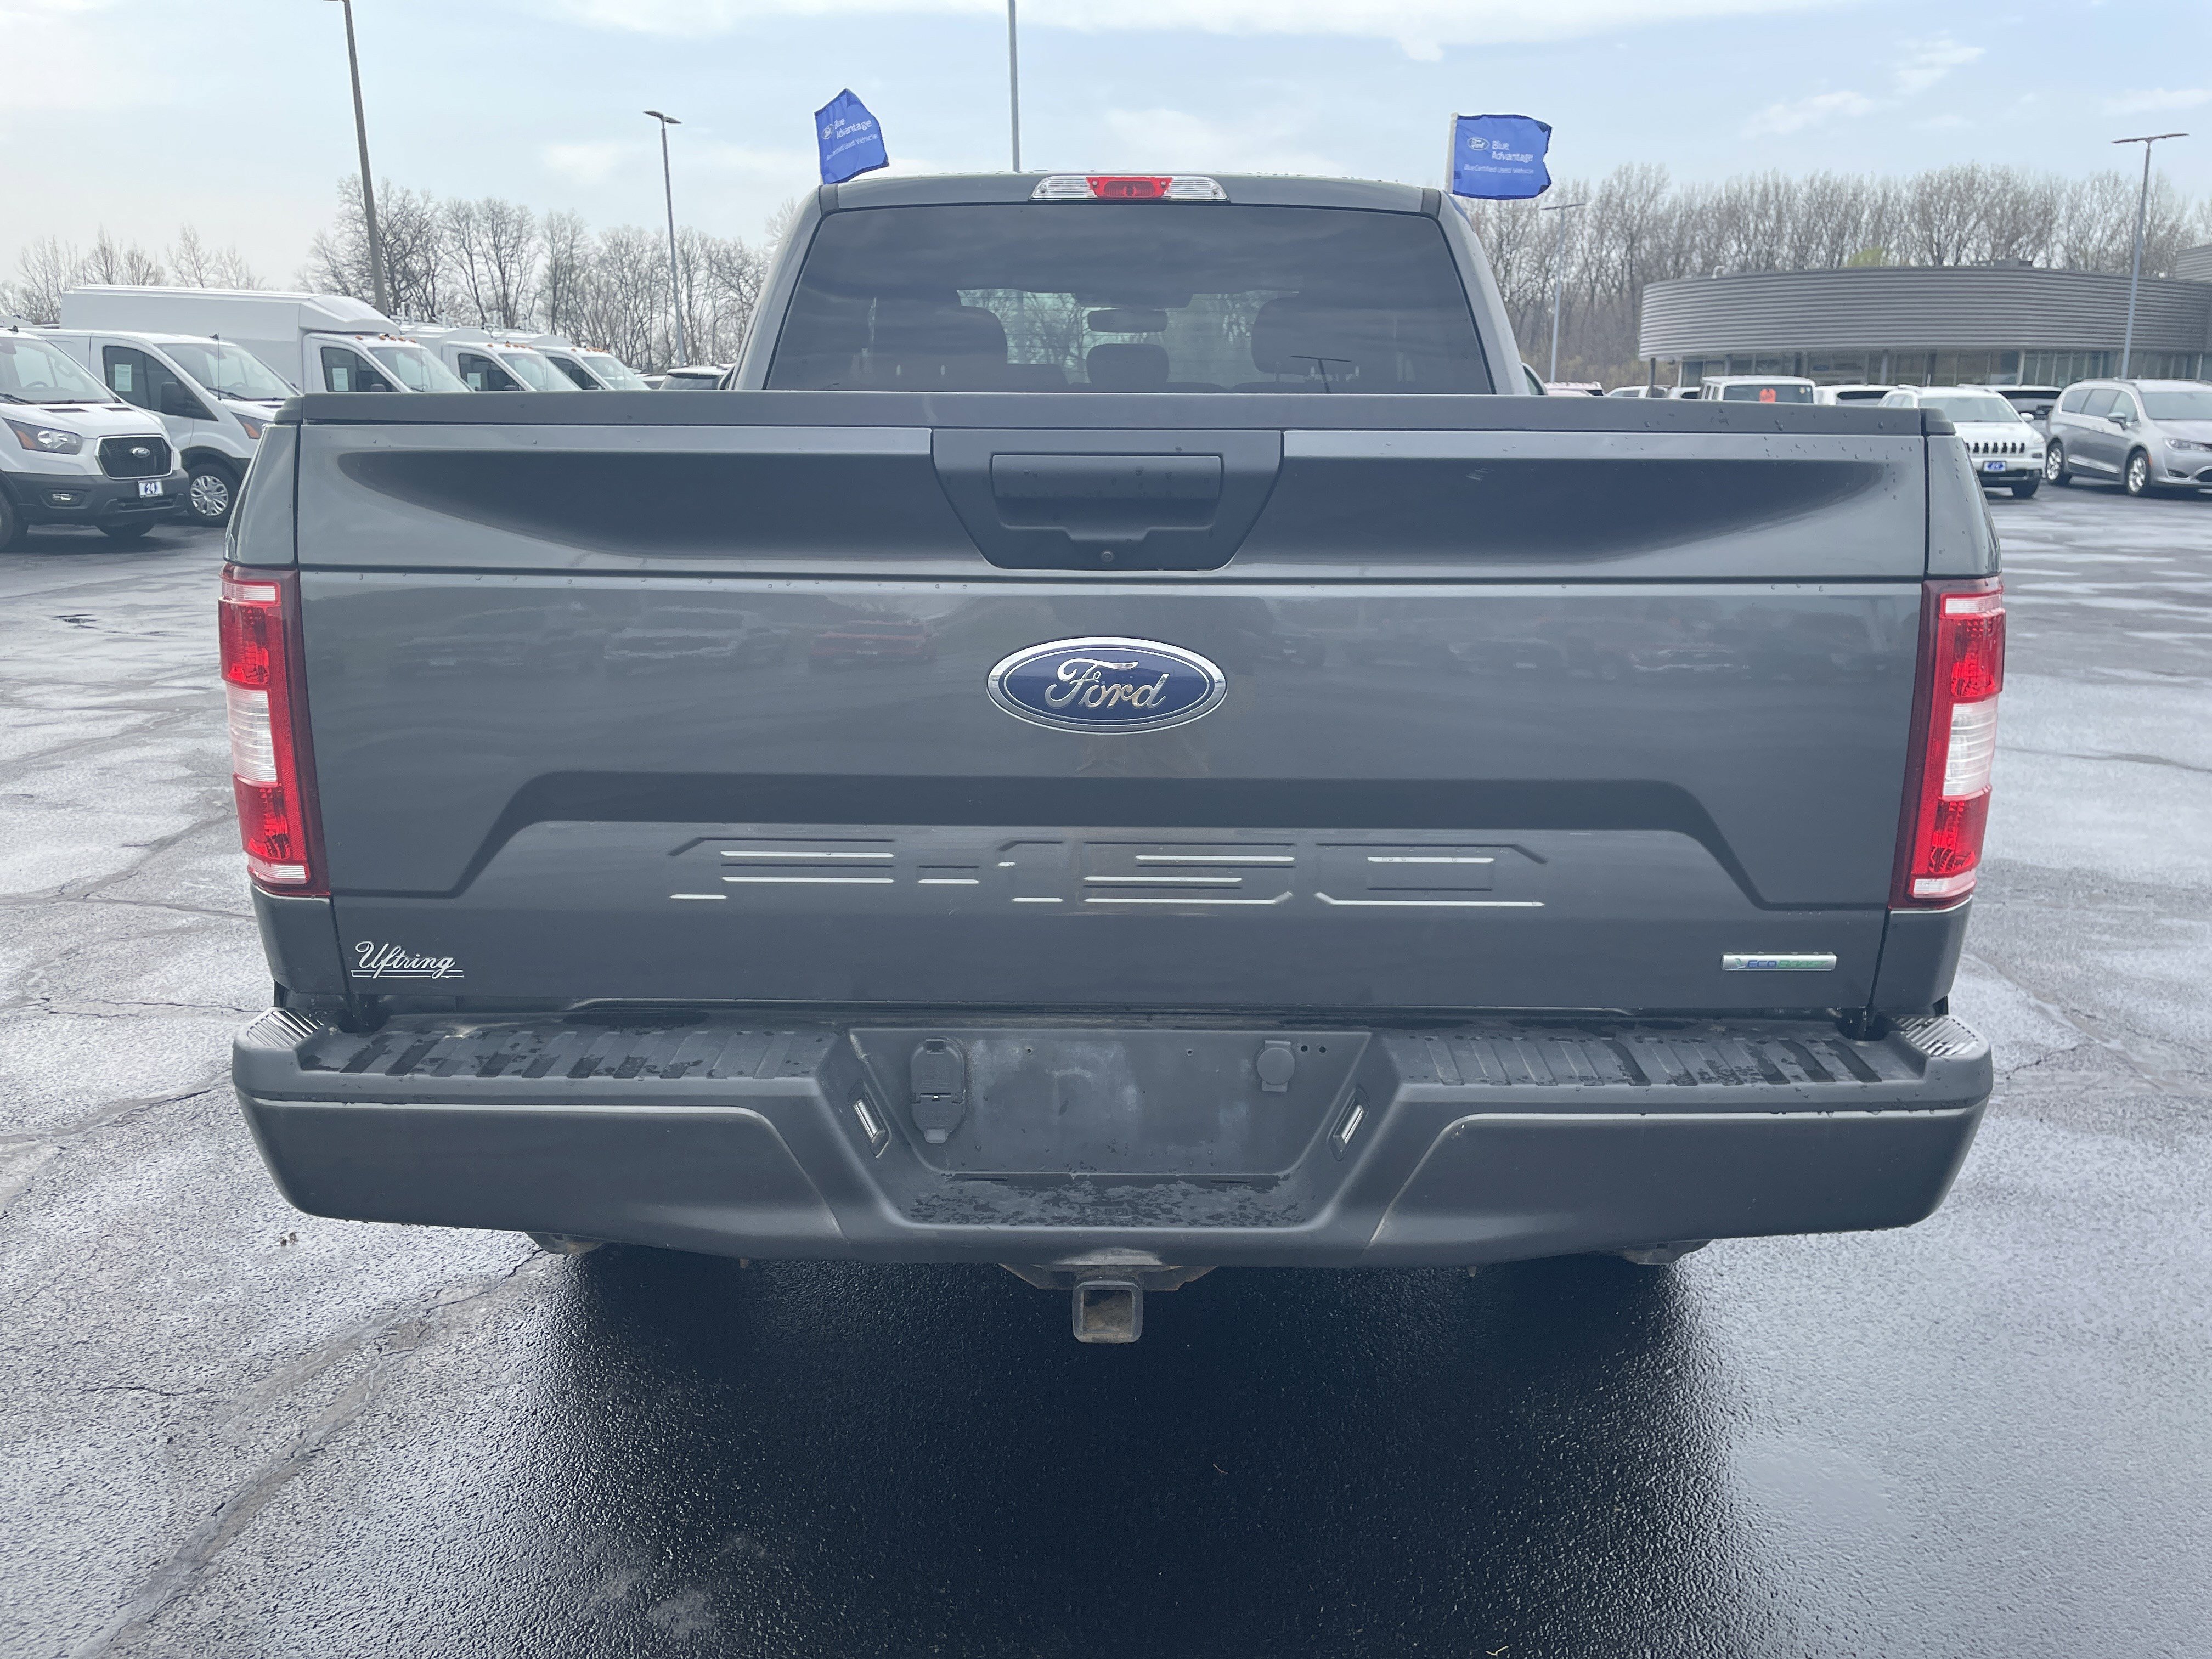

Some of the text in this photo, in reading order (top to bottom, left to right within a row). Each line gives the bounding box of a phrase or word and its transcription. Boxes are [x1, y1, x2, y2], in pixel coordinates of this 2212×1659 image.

[1492, 140, 1509, 150] Blue
[1492, 151, 1533, 163] Advantage
[146, 483, 155, 494] 24
[1044, 658, 1170, 709] Ford
[355, 941, 455, 979] Uftring
